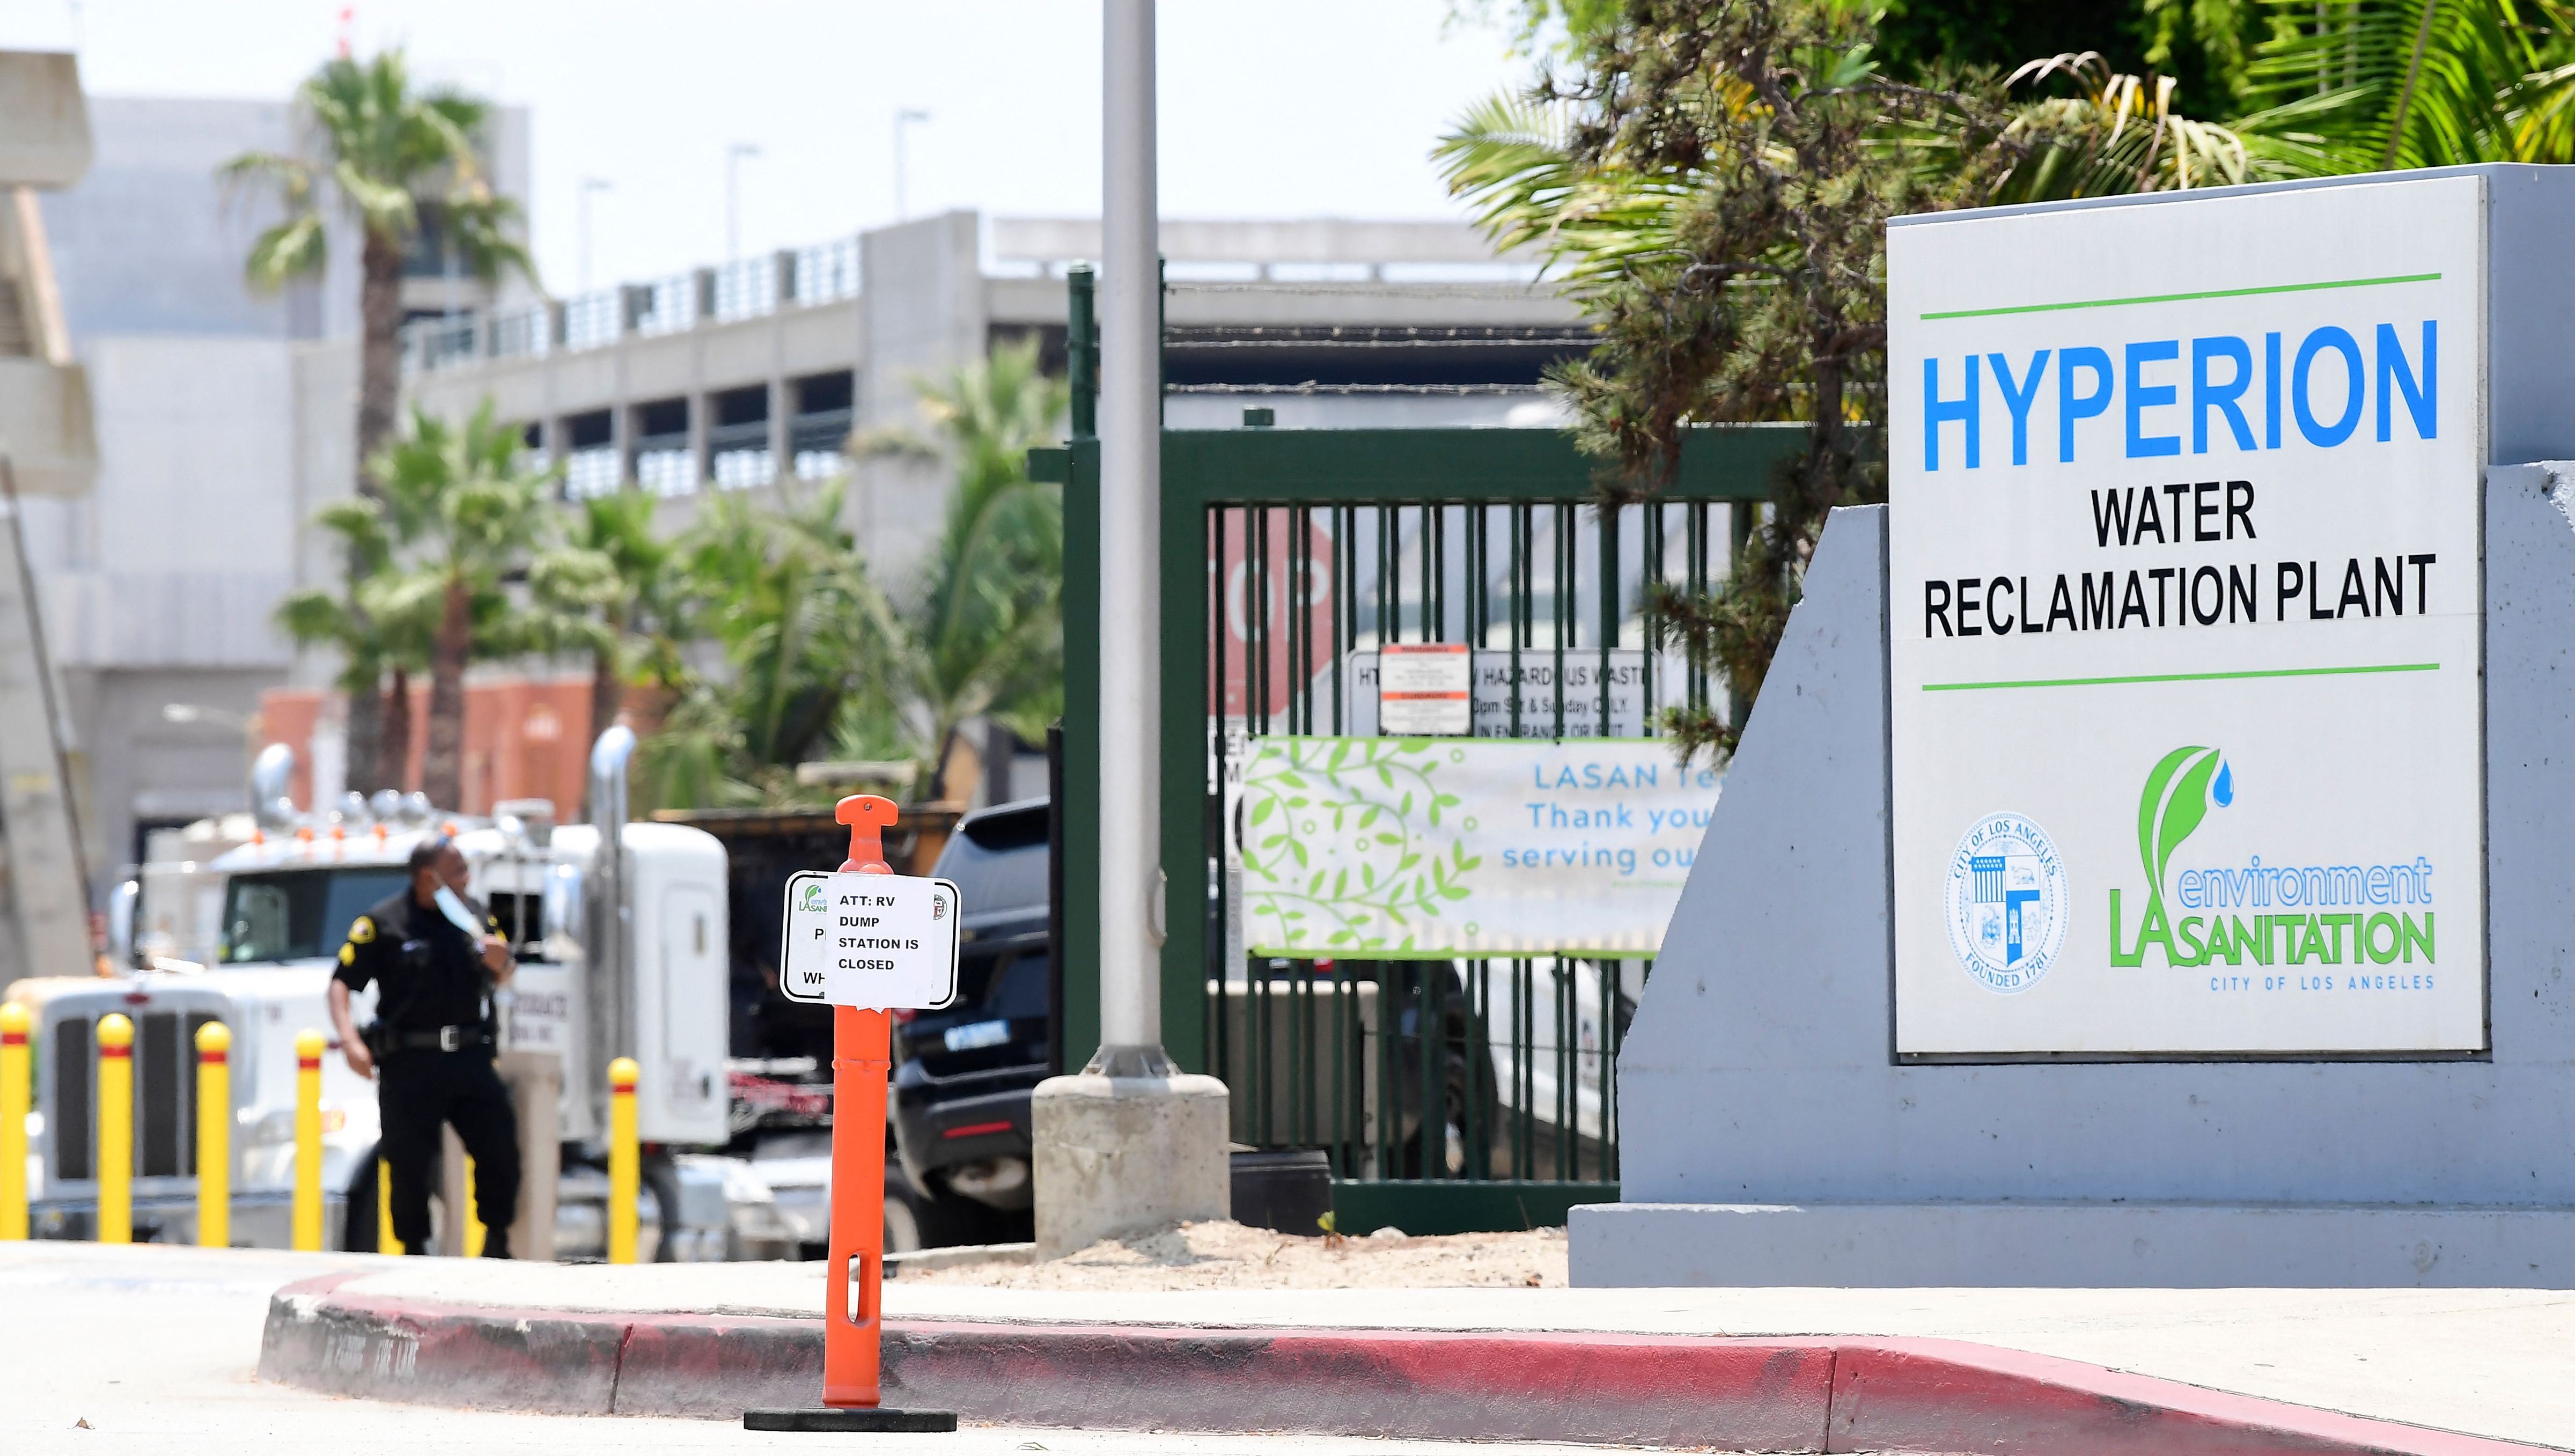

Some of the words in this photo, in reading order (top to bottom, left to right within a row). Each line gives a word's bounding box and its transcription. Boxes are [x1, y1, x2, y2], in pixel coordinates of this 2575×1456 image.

[1924, 320, 2437, 472] HYPERION
[2091, 480, 2256, 547] WATER
[1924, 563, 2257, 638] RECLAMATION
[2277, 554, 2436, 620] PLANT
[1542, 697, 1590, 717] Suday
[1535, 763, 1658, 790] LASAN
[1526, 803, 1633, 828] Thank
[1649, 808, 1710, 834] you
[1503, 841, 1636, 876] serving
[1954, 845, 1971, 879] CITY
[1971, 831, 1985, 846] OF
[1988, 820, 2010, 835] LOS
[2015, 823, 2057, 877] ANGELES
[2179, 856, 2432, 908] environment
[840, 895, 872, 906] ATT:
[876, 896, 895, 906] RV
[815, 928, 826, 940] P
[840, 916, 879, 927] DUMP
[839, 938, 900, 948] STATION
[906, 939, 918, 949] IS
[838, 959, 894, 970] CLOSED
[1965, 952, 2020, 987] FOUNDED
[2026, 952, 2049, 980] 1781
[2211, 977, 2250, 991] CITY
[2265, 977, 2286, 991] OF
[2301, 976, 2334, 991] LOS
[2349, 975, 2434, 991] ANGELES
